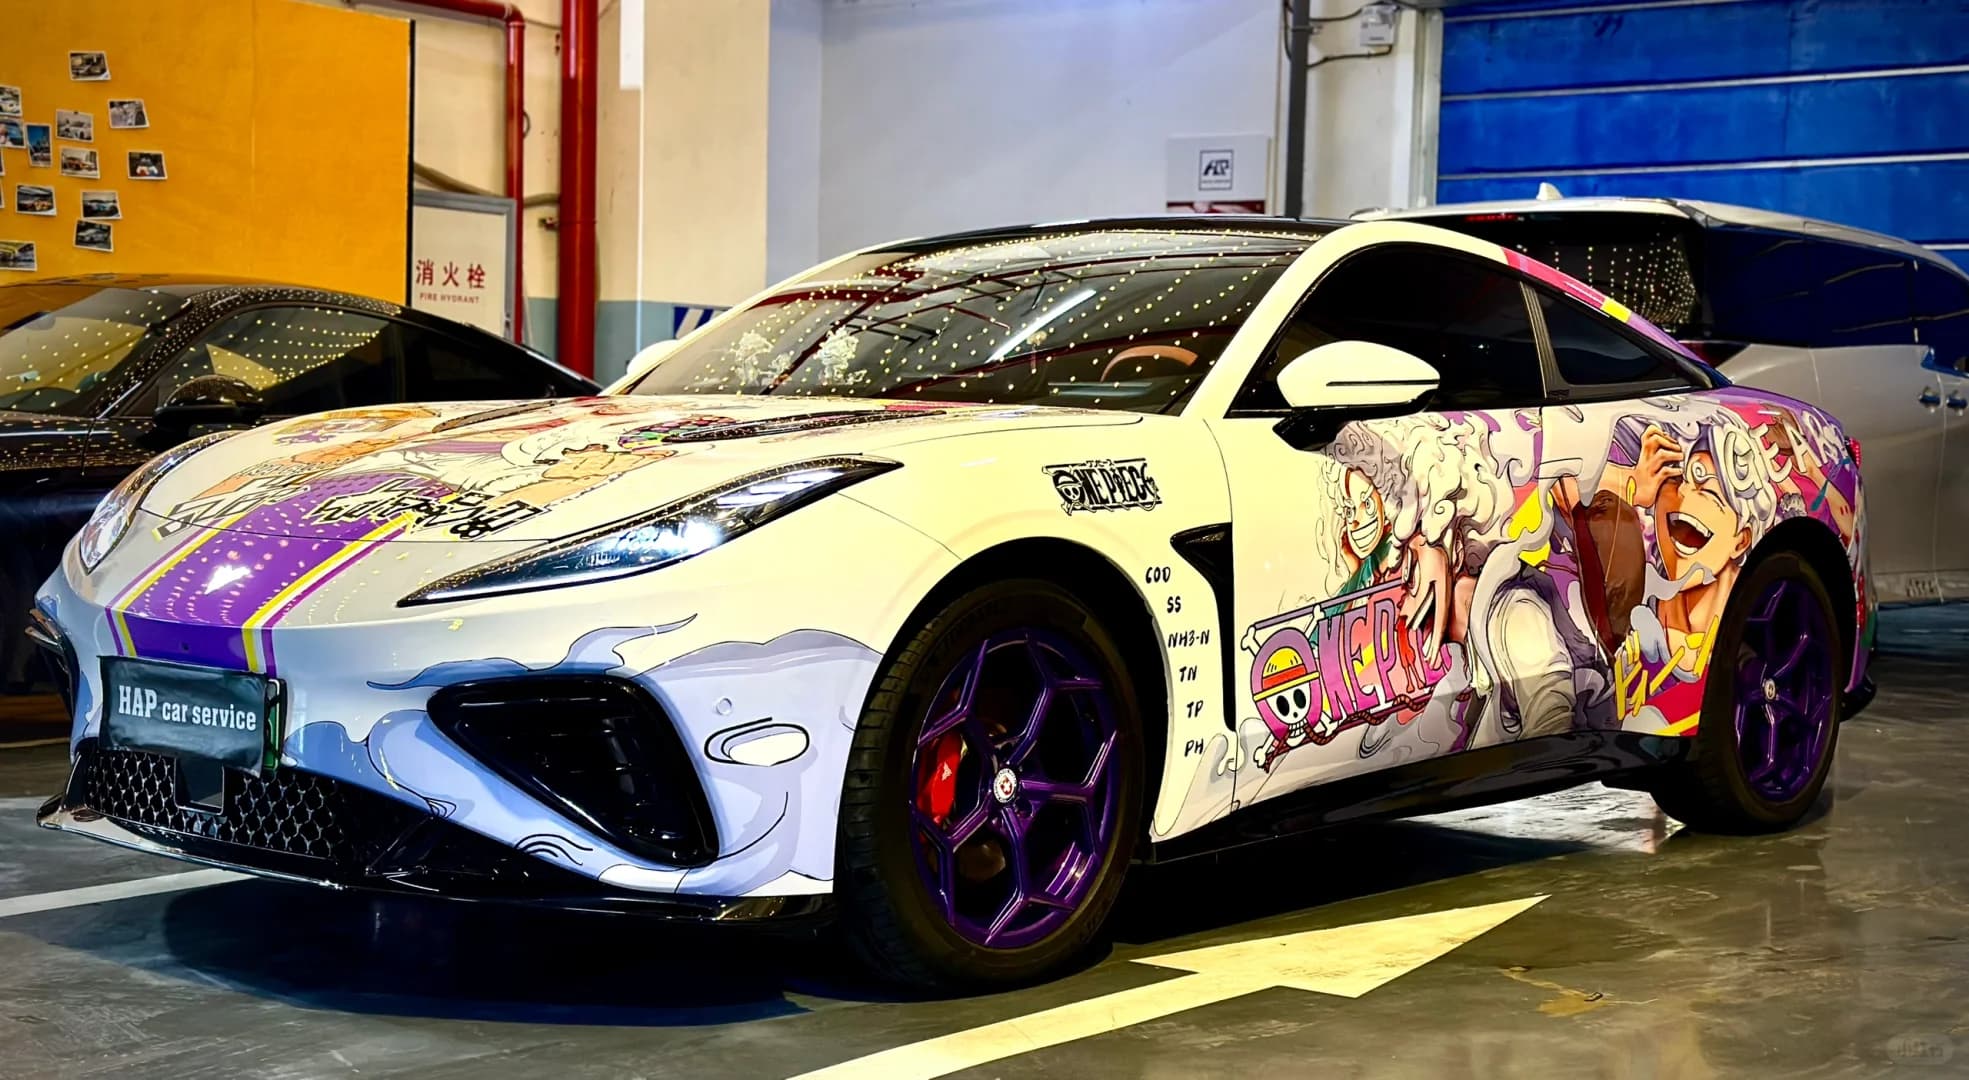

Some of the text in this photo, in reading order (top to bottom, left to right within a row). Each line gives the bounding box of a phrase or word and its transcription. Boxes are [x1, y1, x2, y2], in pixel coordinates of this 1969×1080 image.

[416, 259, 485, 288] 消火栓
[420, 293, 480, 304] FIRE HYDRANT
[1167, 596, 1181, 613] SS
[1167, 629, 1210, 648] NH3-N
[1179, 665, 1197, 682] TN
[1250, 603, 1380, 746] ONE
[118, 685, 257, 731] HAP car service
[1187, 700, 1204, 718] TP
[1184, 738, 1204, 757] PH
